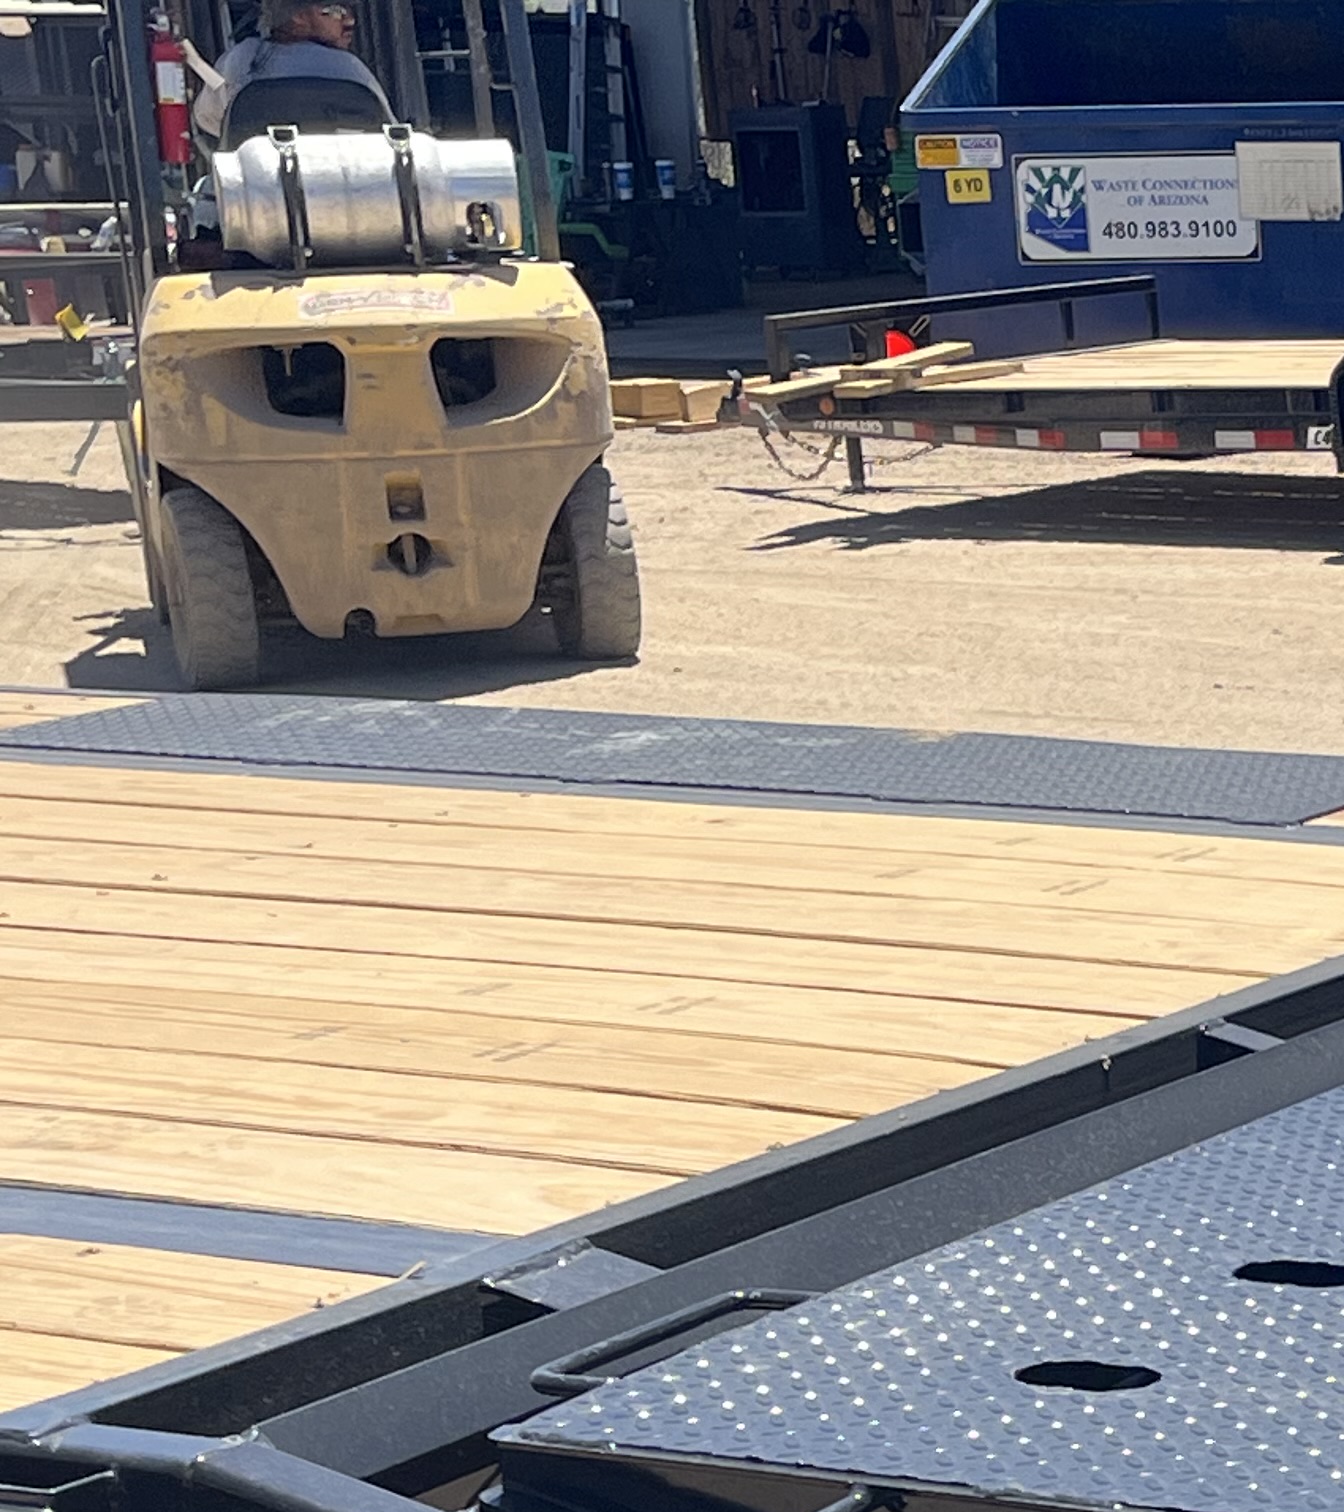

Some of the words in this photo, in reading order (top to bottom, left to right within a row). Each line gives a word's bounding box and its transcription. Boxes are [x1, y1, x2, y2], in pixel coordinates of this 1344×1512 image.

[953, 178, 963, 194] 6
[964, 177, 983, 193] YD
[1141, 177, 1239, 192] CONNECTION
[1127, 195, 1145, 207] OF
[1148, 194, 1209, 207] ARIZONA
[1102, 219, 1237, 239] 480.983.9100
